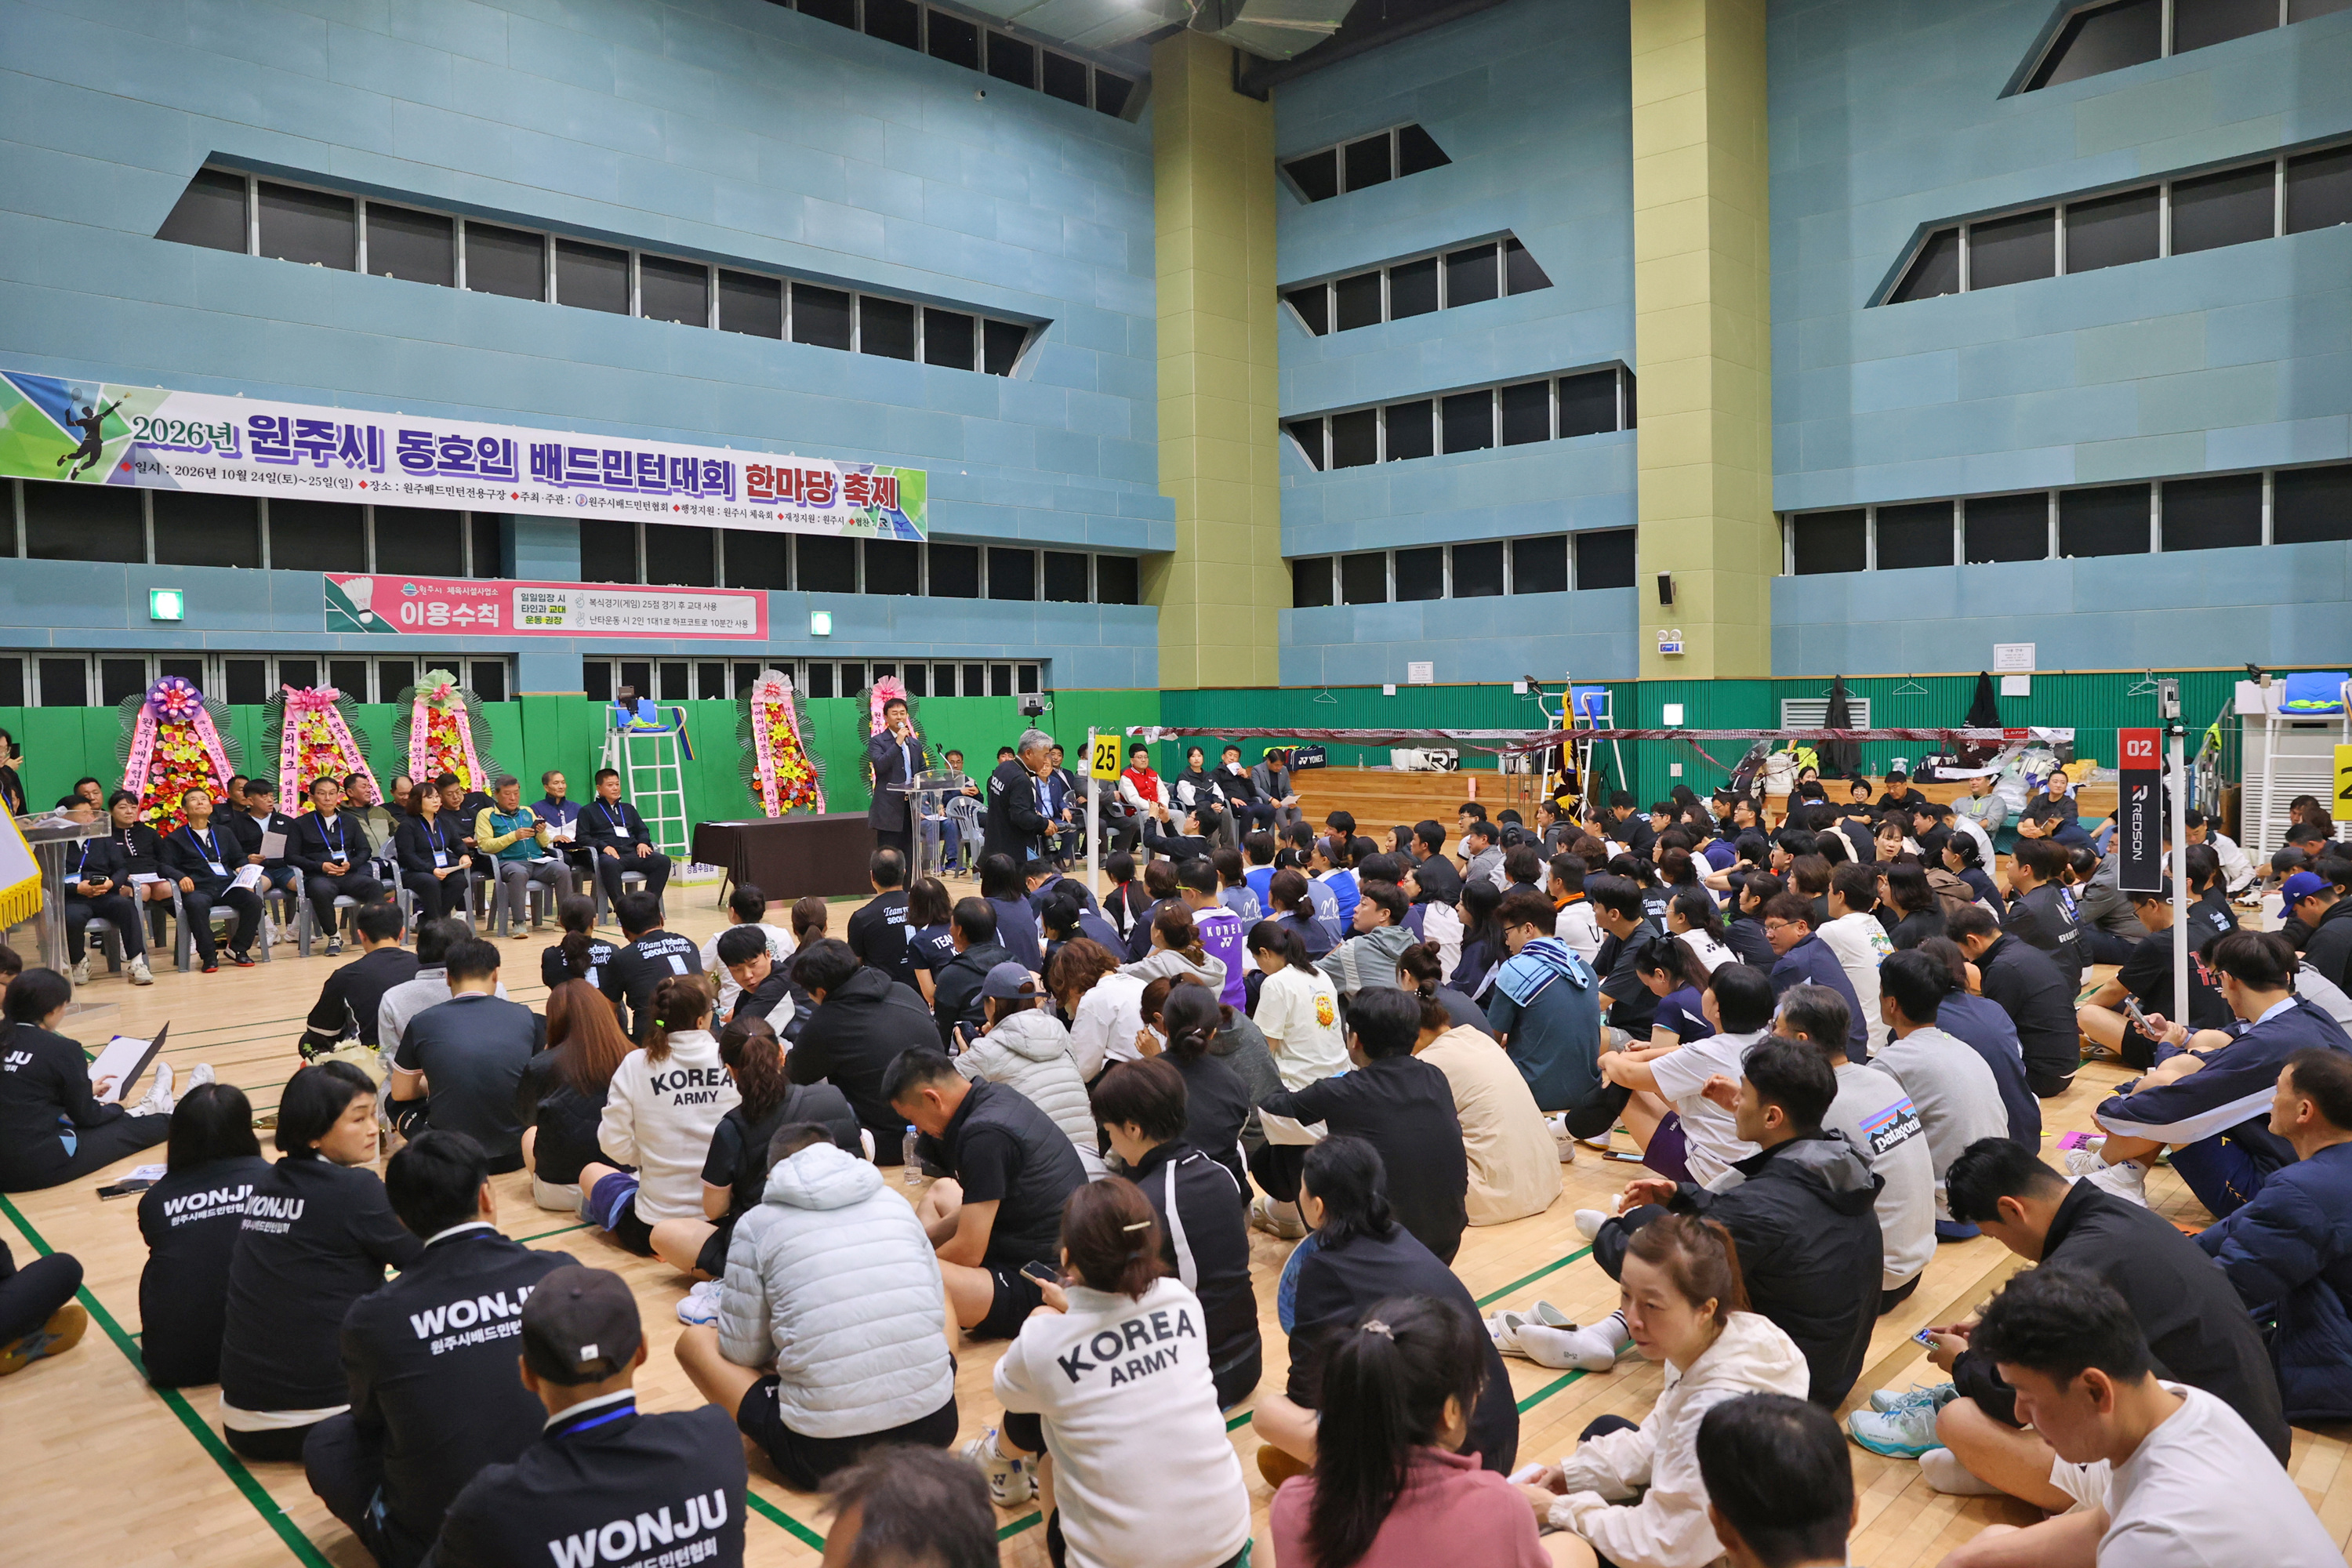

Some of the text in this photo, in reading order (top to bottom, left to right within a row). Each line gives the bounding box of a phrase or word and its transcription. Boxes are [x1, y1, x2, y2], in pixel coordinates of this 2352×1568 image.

[132, 415, 897, 510] 2026년 원주시 동호인 배드민턴대회 한마당 축제
[135, 461, 160, 475] 일시
[174, 466, 216, 480] 2026년
[222, 469, 247, 482] 10월
[251, 472, 353, 491] 24일(토)~25일(일)
[369, 480, 392, 492] 장소
[403, 482, 506, 500] 원주배드민턴전용구장
[589, 496, 669, 513] 원주시배드민턴협회
[681, 504, 715, 517] 행정지원
[723, 507, 747, 519] 원주시
[750, 510, 773, 521] 체육회
[785, 513, 815, 524] 재정지원
[822, 515, 844, 525] 원주시
[855, 517, 870, 528] 협찬
[419, 584, 499, 596] 원주시 체육시설사업소
[521, 593, 566, 603] 일일입장 시
[521, 604, 566, 614] 타인과 교대
[589, 597, 717, 612] 복식경기(게임) 25점 경기 후 교대 사용
[401, 601, 499, 628] 이용수칙
[525, 615, 563, 625] 운동 권장
[590, 615, 749, 629] 난타운동 시 2인 1대1로 하프코트로 10분간 사용
[414, 717, 423, 743] 2026
[873, 711, 883, 735] 원주시
[332, 722, 347, 741] 원주시
[344, 744, 358, 764] 동호인
[2126, 740, 2153, 757] 02
[1095, 744, 1116, 771] 25
[1308, 753, 1324, 764] YONEX
[412, 770, 423, 782] 동호
[764, 768, 773, 782] 대표
[285, 779, 294, 814] 대표이사
[766, 789, 778, 816] 이두영
[2132, 802, 2143, 861] REDSON
[884, 906, 903, 917] Team
[1206, 923, 1242, 938] KOREA
[588, 944, 612, 955] edson
[637, 940, 661, 953] Team
[642, 943, 691, 960] seoul Osaka
[650, 1068, 733, 1096] KOREA
[673, 1090, 719, 1106] ARMY
[1874, 1116, 1922, 1153] patagoni
[1057, 1308, 1197, 1384] KOREA
[1110, 1344, 1179, 1388] ARMY
[548, 1488, 728, 1568] WONJU
